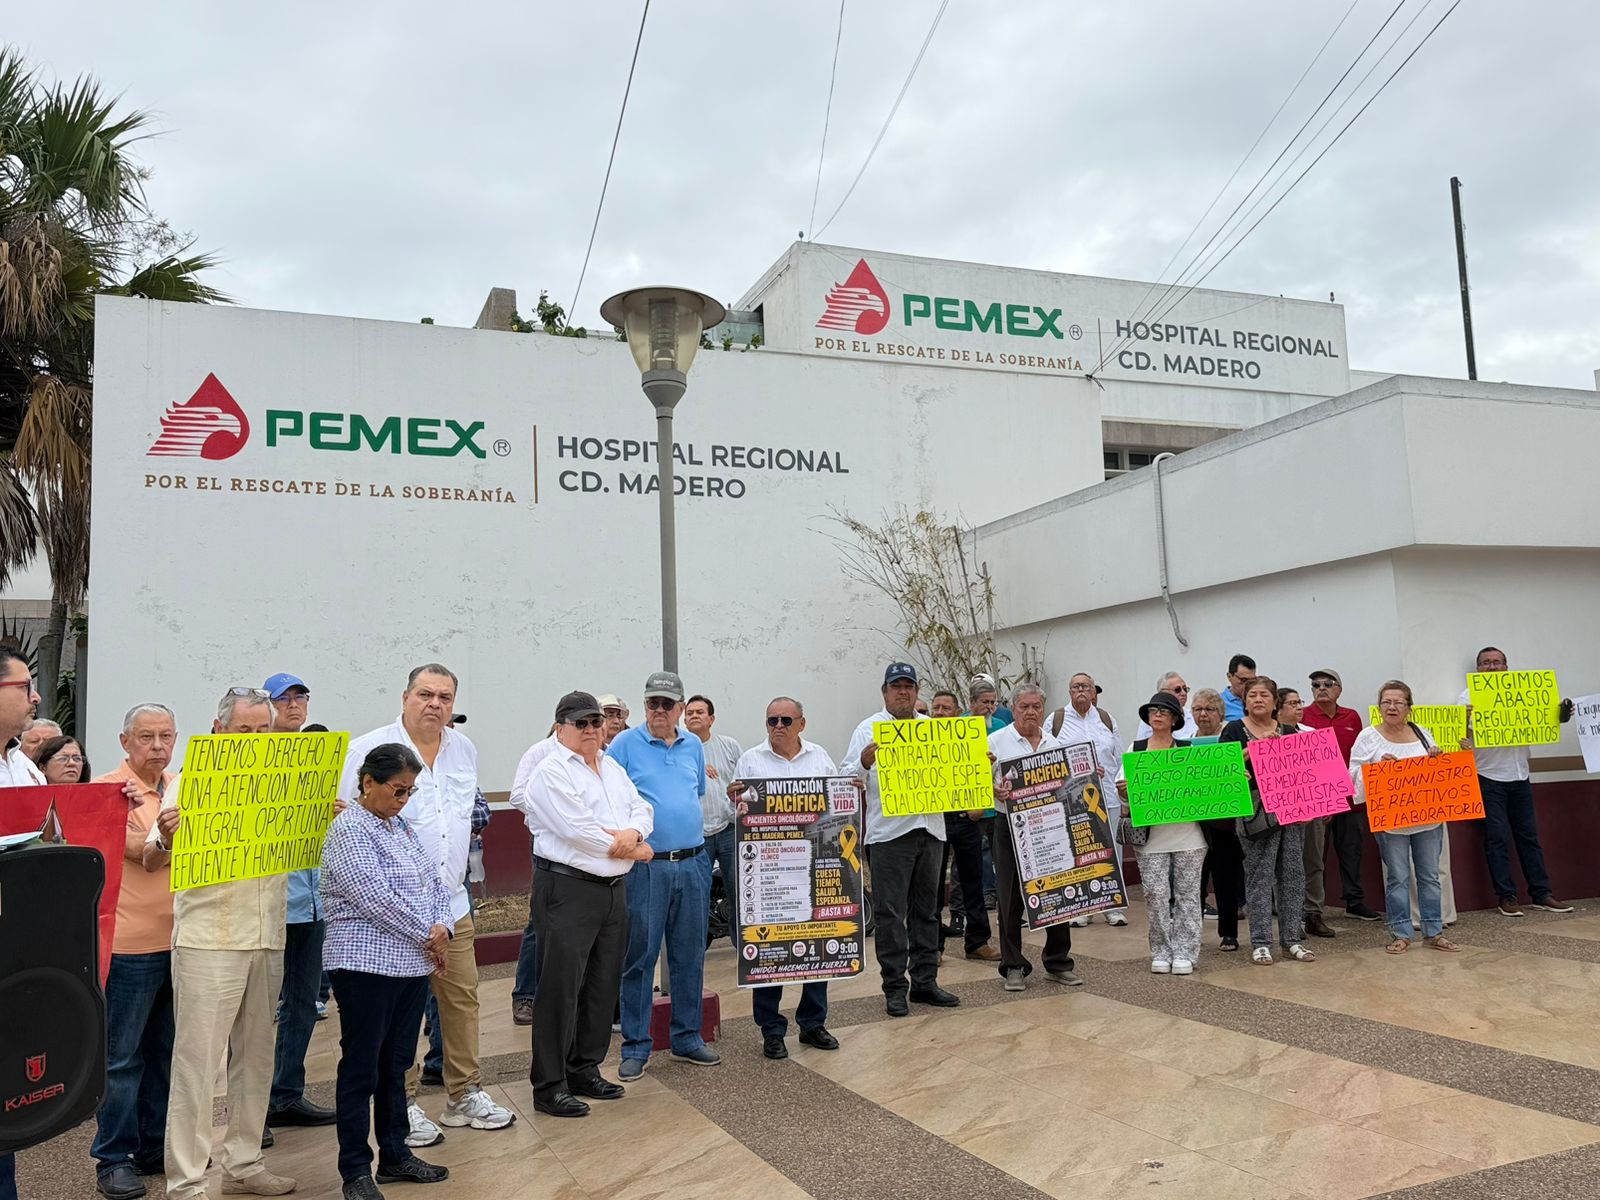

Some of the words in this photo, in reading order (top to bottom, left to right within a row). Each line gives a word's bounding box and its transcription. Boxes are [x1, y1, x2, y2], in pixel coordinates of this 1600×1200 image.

[903, 293, 1064, 340] PEMEX
[1115, 319, 1227, 348] HOSPITAL
[1233, 330, 1339, 358] REGIONAL
[815, 337, 845, 351] POR
[852, 340, 871, 353] EL
[876, 342, 946, 360] RESCATE
[950, 349, 971, 362] DE
[976, 351, 995, 364] LA
[999, 353, 1083, 371] SOBERANÍA
[1118, 350, 1157, 371] CD.
[1163, 353, 1261, 380] MADERO
[266, 409, 487, 459] PEMEX
[711, 445, 849, 474] REGIONAL
[144, 474, 187, 489] POR
[196, 476, 222, 491] EL
[230, 477, 327, 496] RESCATE
[335, 481, 361, 497] DE
[369, 483, 396, 498] LA
[402, 485, 517, 504] SOBERANÍA
[559, 470, 610, 493] CD.
[1472, 671, 1553, 691] EXIGIMOS
[1493, 690, 1550, 708] ABASTO
[1475, 709, 1531, 728] REGULAR
[1535, 708, 1550, 725] DE
[880, 718, 980, 745] EXIGIMOS
[1475, 725, 1558, 746] MEDICAMENTOS
[190, 738, 260, 772] TENEMOS
[264, 736, 326, 769] DERECHO
[330, 736, 343, 766] A
[877, 742, 971, 769] CONTRATACION
[1022, 749, 1063, 770] INVITACIÓN
[1135, 743, 1238, 770] EXIGIMOS
[1255, 760, 1269, 776] LA
[1268, 745, 1339, 774] CONTRATACION
[1367, 753, 1451, 777] EXIGIMOS
[879, 769, 892, 791] DE
[897, 766, 946, 791] MEDICOS
[1023, 762, 1069, 786] PACÍFICA
[1072, 762, 1091, 773] VIDA
[1132, 769, 1183, 788] ABASTO
[1185, 762, 1242, 781] REGULAR
[181, 777, 212, 811] UNA
[216, 772, 292, 808] ATENCION
[294, 770, 339, 801] MEDICA
[766, 778, 823, 795] INVITACIÓN
[1260, 776, 1274, 794] DE
[1275, 768, 1317, 789] MEDICOS
[1368, 779, 1380, 796] EL
[1387, 765, 1473, 791] SUMINISTRO
[766, 793, 826, 813] PACÍFICA
[833, 799, 855, 810] VIDA
[946, 786, 992, 809] VACANTES
[1132, 791, 1147, 805] DE
[1149, 781, 1243, 803] MEDICAMENTOS
[1265, 780, 1349, 811] ESPECIALISTAS
[1370, 797, 1385, 812] DE
[1389, 784, 1470, 809] REACTIVOS
[747, 815, 776, 825] PACIENTES
[1145, 800, 1240, 821] ONCOLOGICOS
[1280, 797, 1348, 822] VACANTES
[1373, 815, 1387, 828] DE
[1394, 801, 1483, 826] LABORATORIO
[179, 811, 251, 849] INTEGRAL,
[255, 802, 330, 839] OPORTUNA
[787, 831, 804, 839] PEMEX
[1071, 821, 1091, 832] CUESTA
[173, 846, 237, 889] EFICIENTE
[242, 845, 250, 876] Y
[815, 869, 840, 878] CUESTA
[816, 878, 842, 887] TIEMPO,
[816, 887, 836, 896] SALUD
[838, 885, 842, 895] Y
[1101, 880, 1118, 891] 9:00
[816, 895, 852, 906] ESPERANZA.
[818, 907, 841, 918] ¡BASTA
[842, 906, 853, 915] YA!
[809, 945, 815, 956] 4
[840, 942, 858, 954] 9:00
[750, 966, 776, 975] UNIDOS
[778, 963, 810, 972] HACEMOS
[821, 960, 848, 968] FUERZA
[4, 1083, 65, 1112] KAISER
